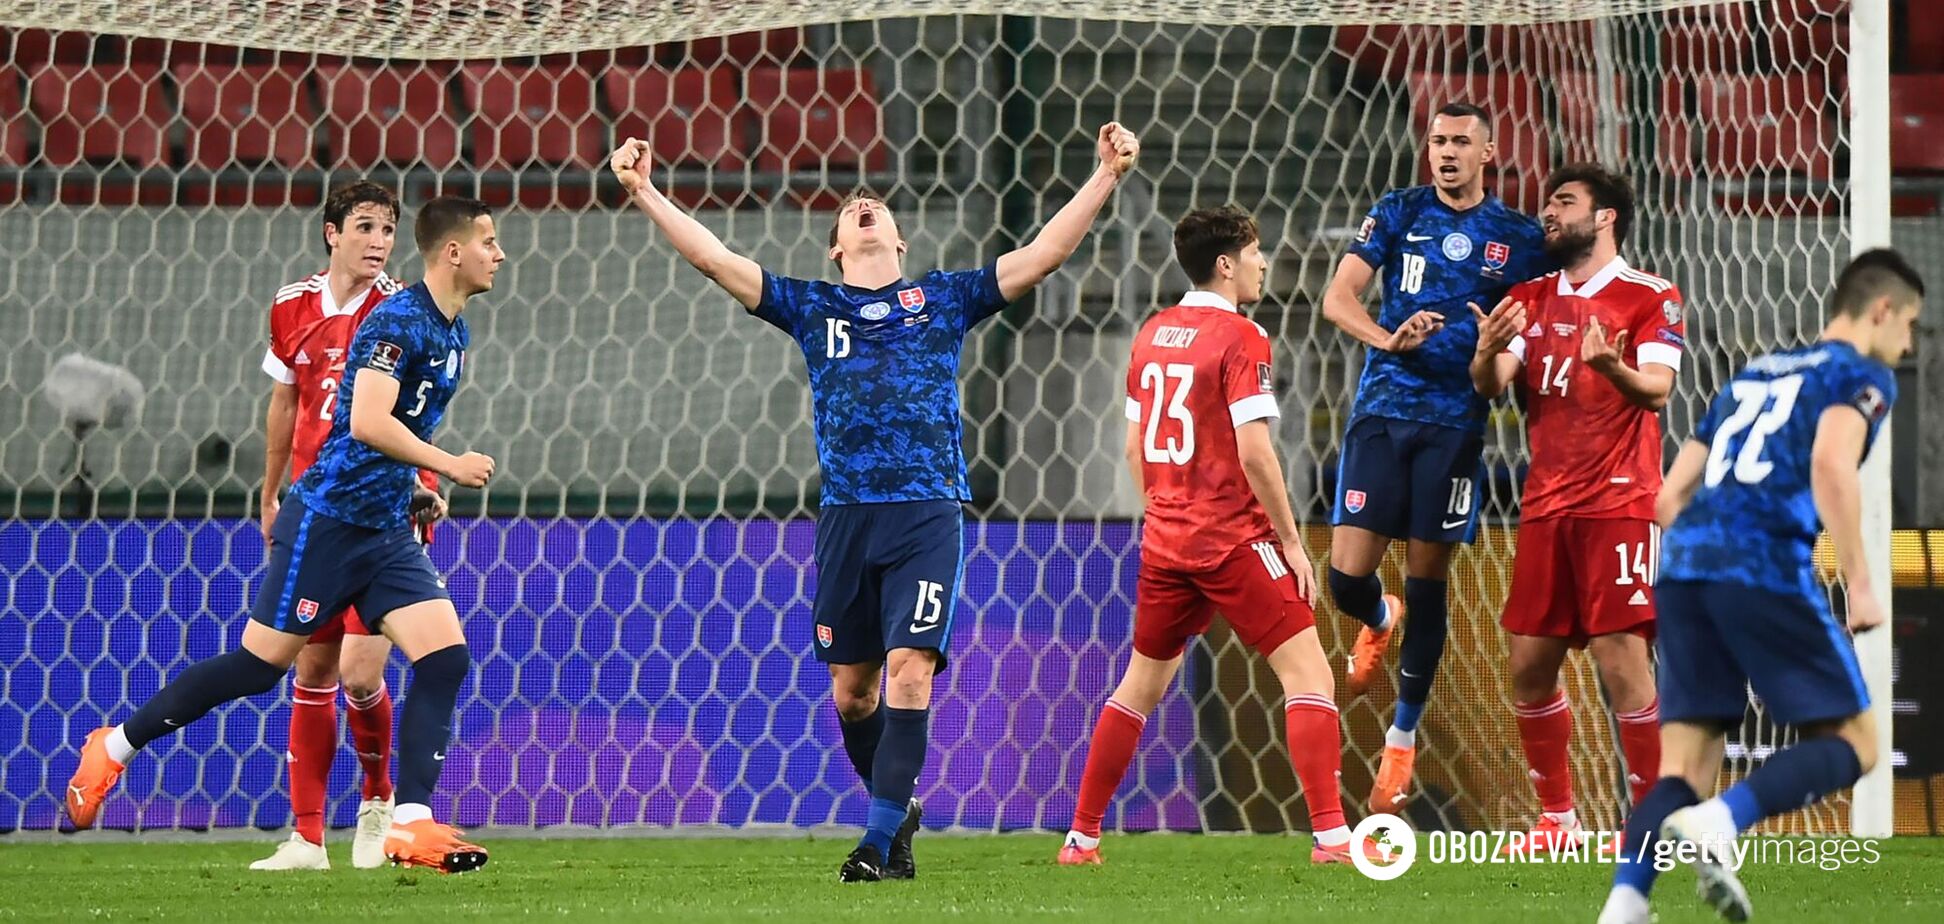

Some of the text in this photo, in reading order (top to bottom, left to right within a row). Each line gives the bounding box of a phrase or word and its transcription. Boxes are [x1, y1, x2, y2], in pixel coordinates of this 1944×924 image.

[1399, 253, 1426, 294] 18
[825, 318, 851, 359] 15
[1539, 354, 1573, 397] 14
[406, 380, 433, 417] 5
[1140, 362, 1196, 466] 23
[1704, 373, 1805, 488] 22
[1447, 477, 1473, 515] 18
[1615, 542, 1648, 585] 14
[914, 580, 943, 623] 15
